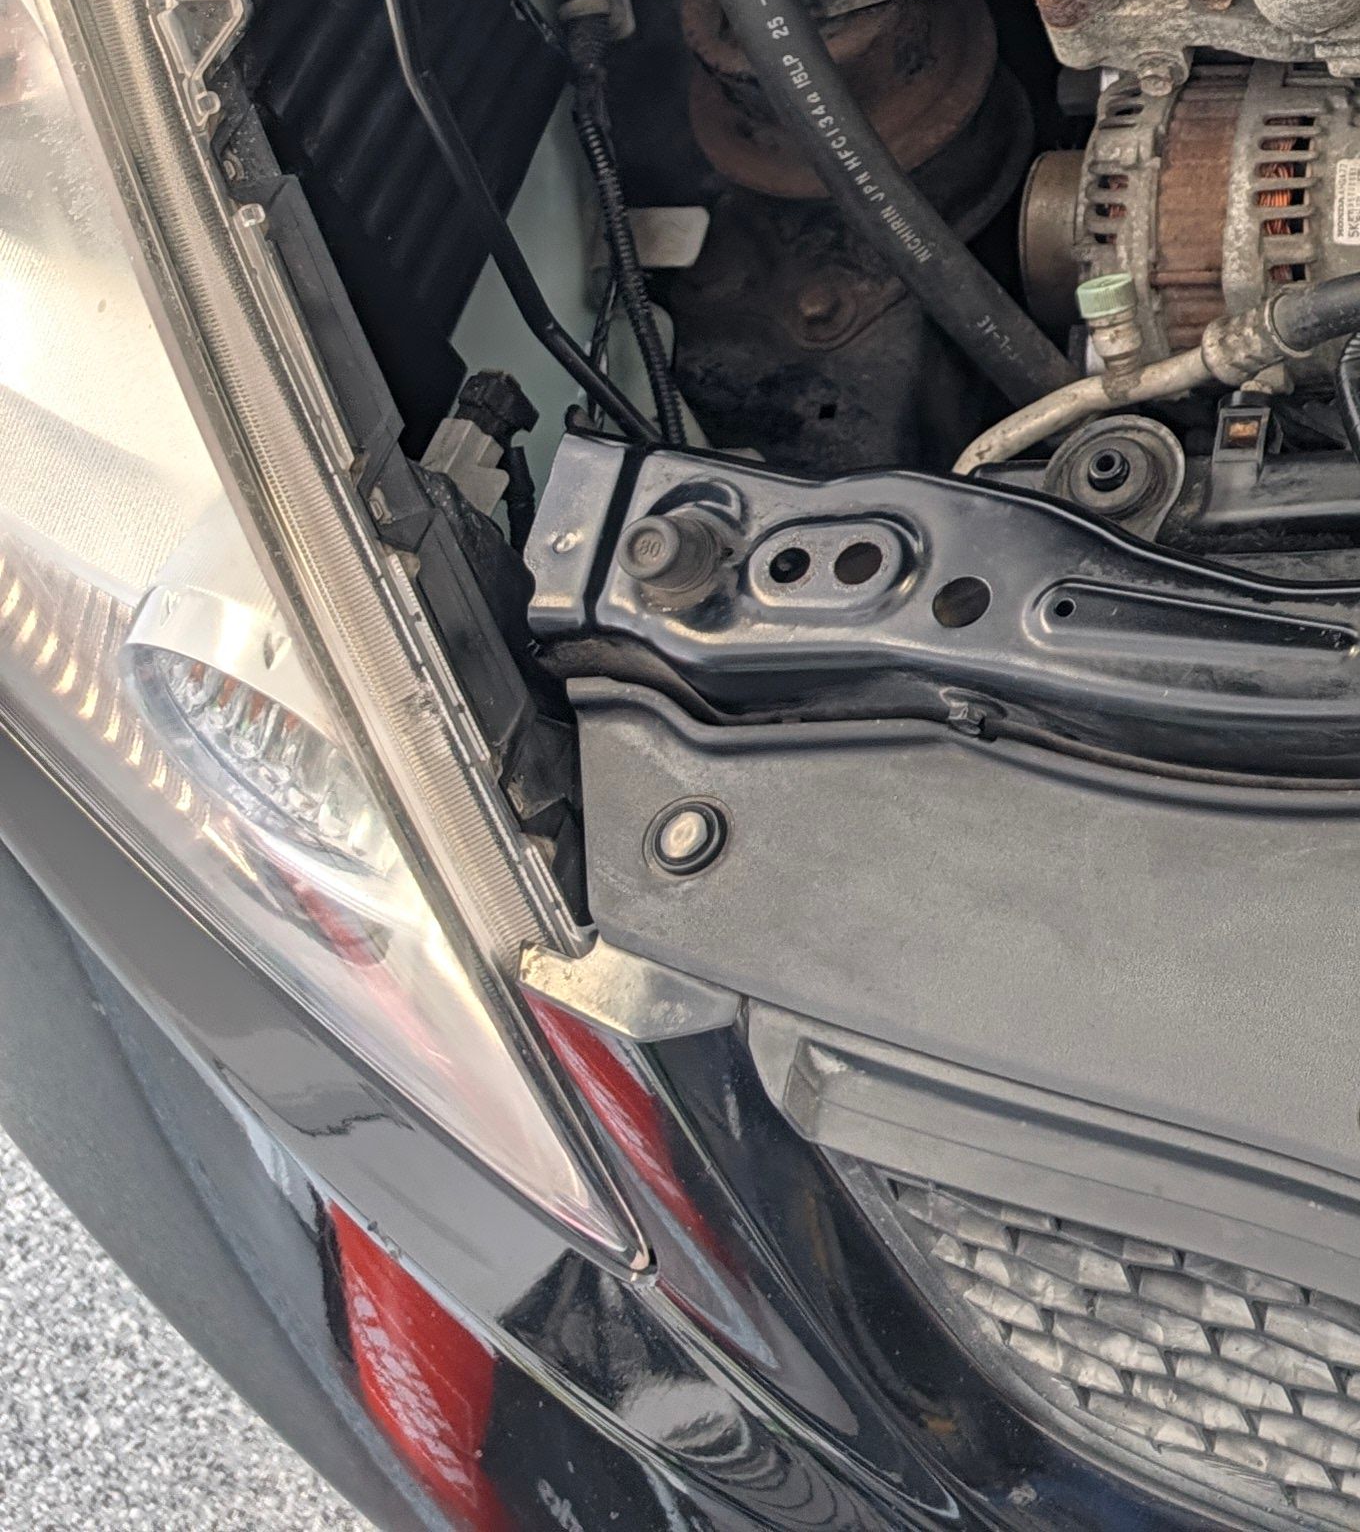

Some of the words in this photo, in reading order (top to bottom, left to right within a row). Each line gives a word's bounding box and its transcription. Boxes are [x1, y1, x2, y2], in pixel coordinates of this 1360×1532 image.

[765, 15, 790, 42] 25
[855, 171, 888, 204] JPN
[879, 205, 933, 264] NICHIRIN
[639, 538, 662, 560] 80
